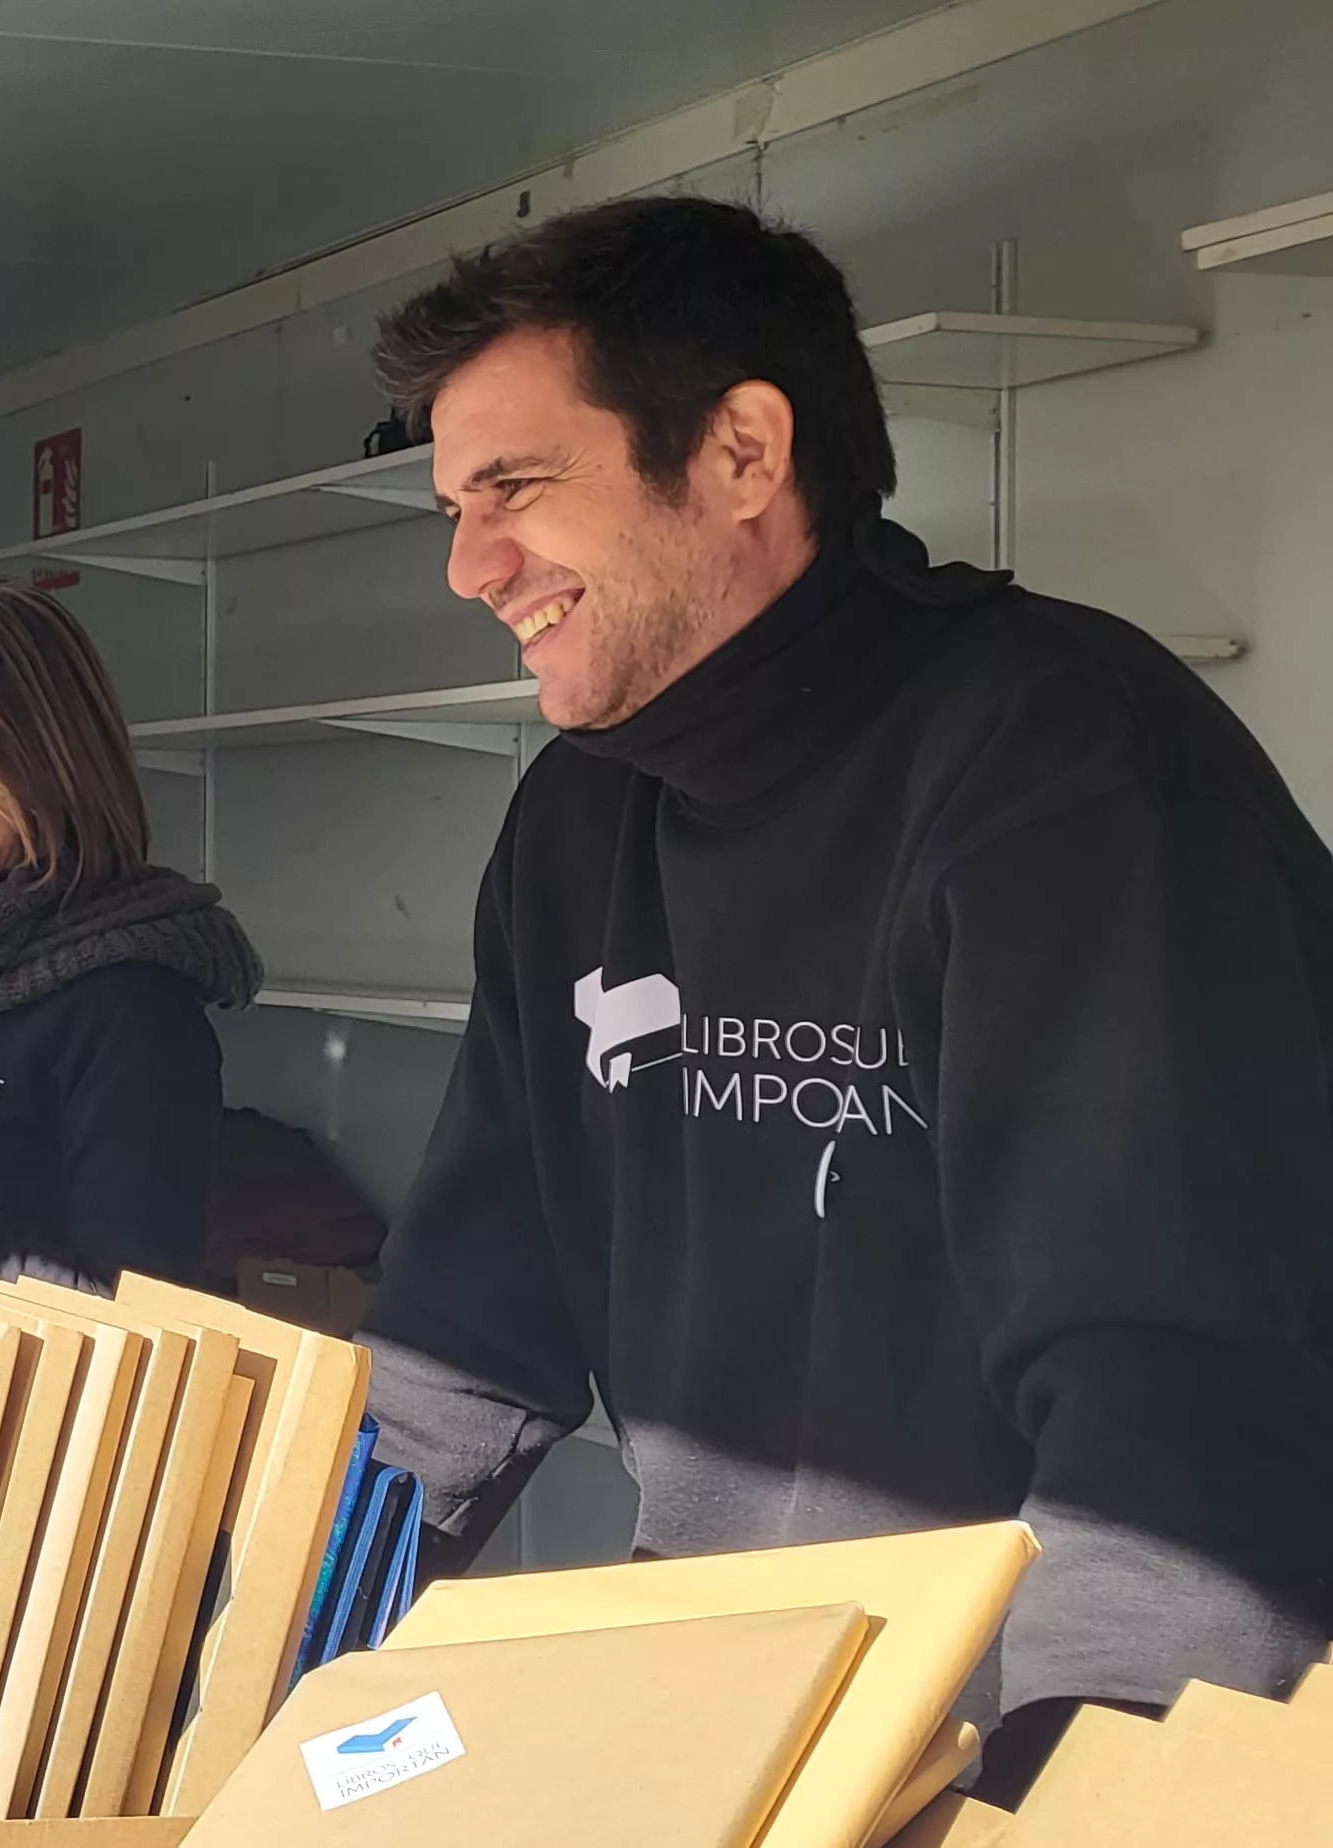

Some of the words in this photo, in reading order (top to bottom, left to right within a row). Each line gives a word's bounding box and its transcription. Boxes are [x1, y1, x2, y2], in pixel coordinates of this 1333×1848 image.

[682, 1013, 855, 1066] LIBROS
[682, 1067, 929, 1135] IMPOAN
[340, 1747, 450, 1798] IMPORTAN
